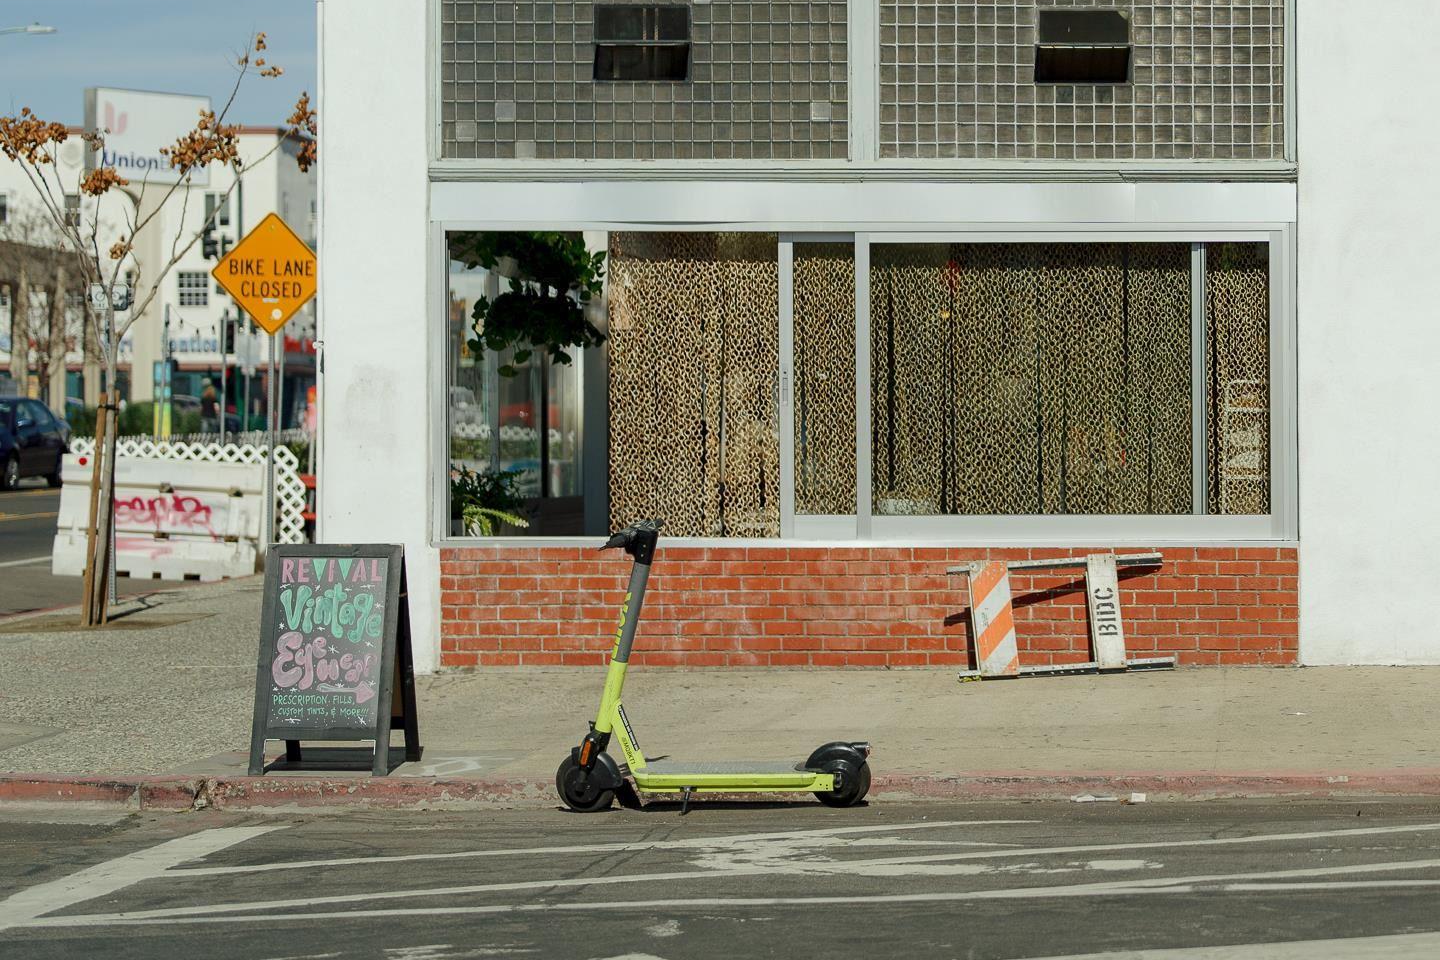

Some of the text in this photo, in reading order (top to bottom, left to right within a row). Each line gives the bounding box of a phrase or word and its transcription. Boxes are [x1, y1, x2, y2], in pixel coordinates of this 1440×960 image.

[229, 259, 314, 276] BIKE LANE
[241, 281, 302, 298] CLOSED
[282, 558, 383, 583] REVIVAL
[280, 582, 382, 643] Vintage
[273, 694, 328, 706] PRESCRIPTION
[278, 707, 304, 717] CUSTOM
